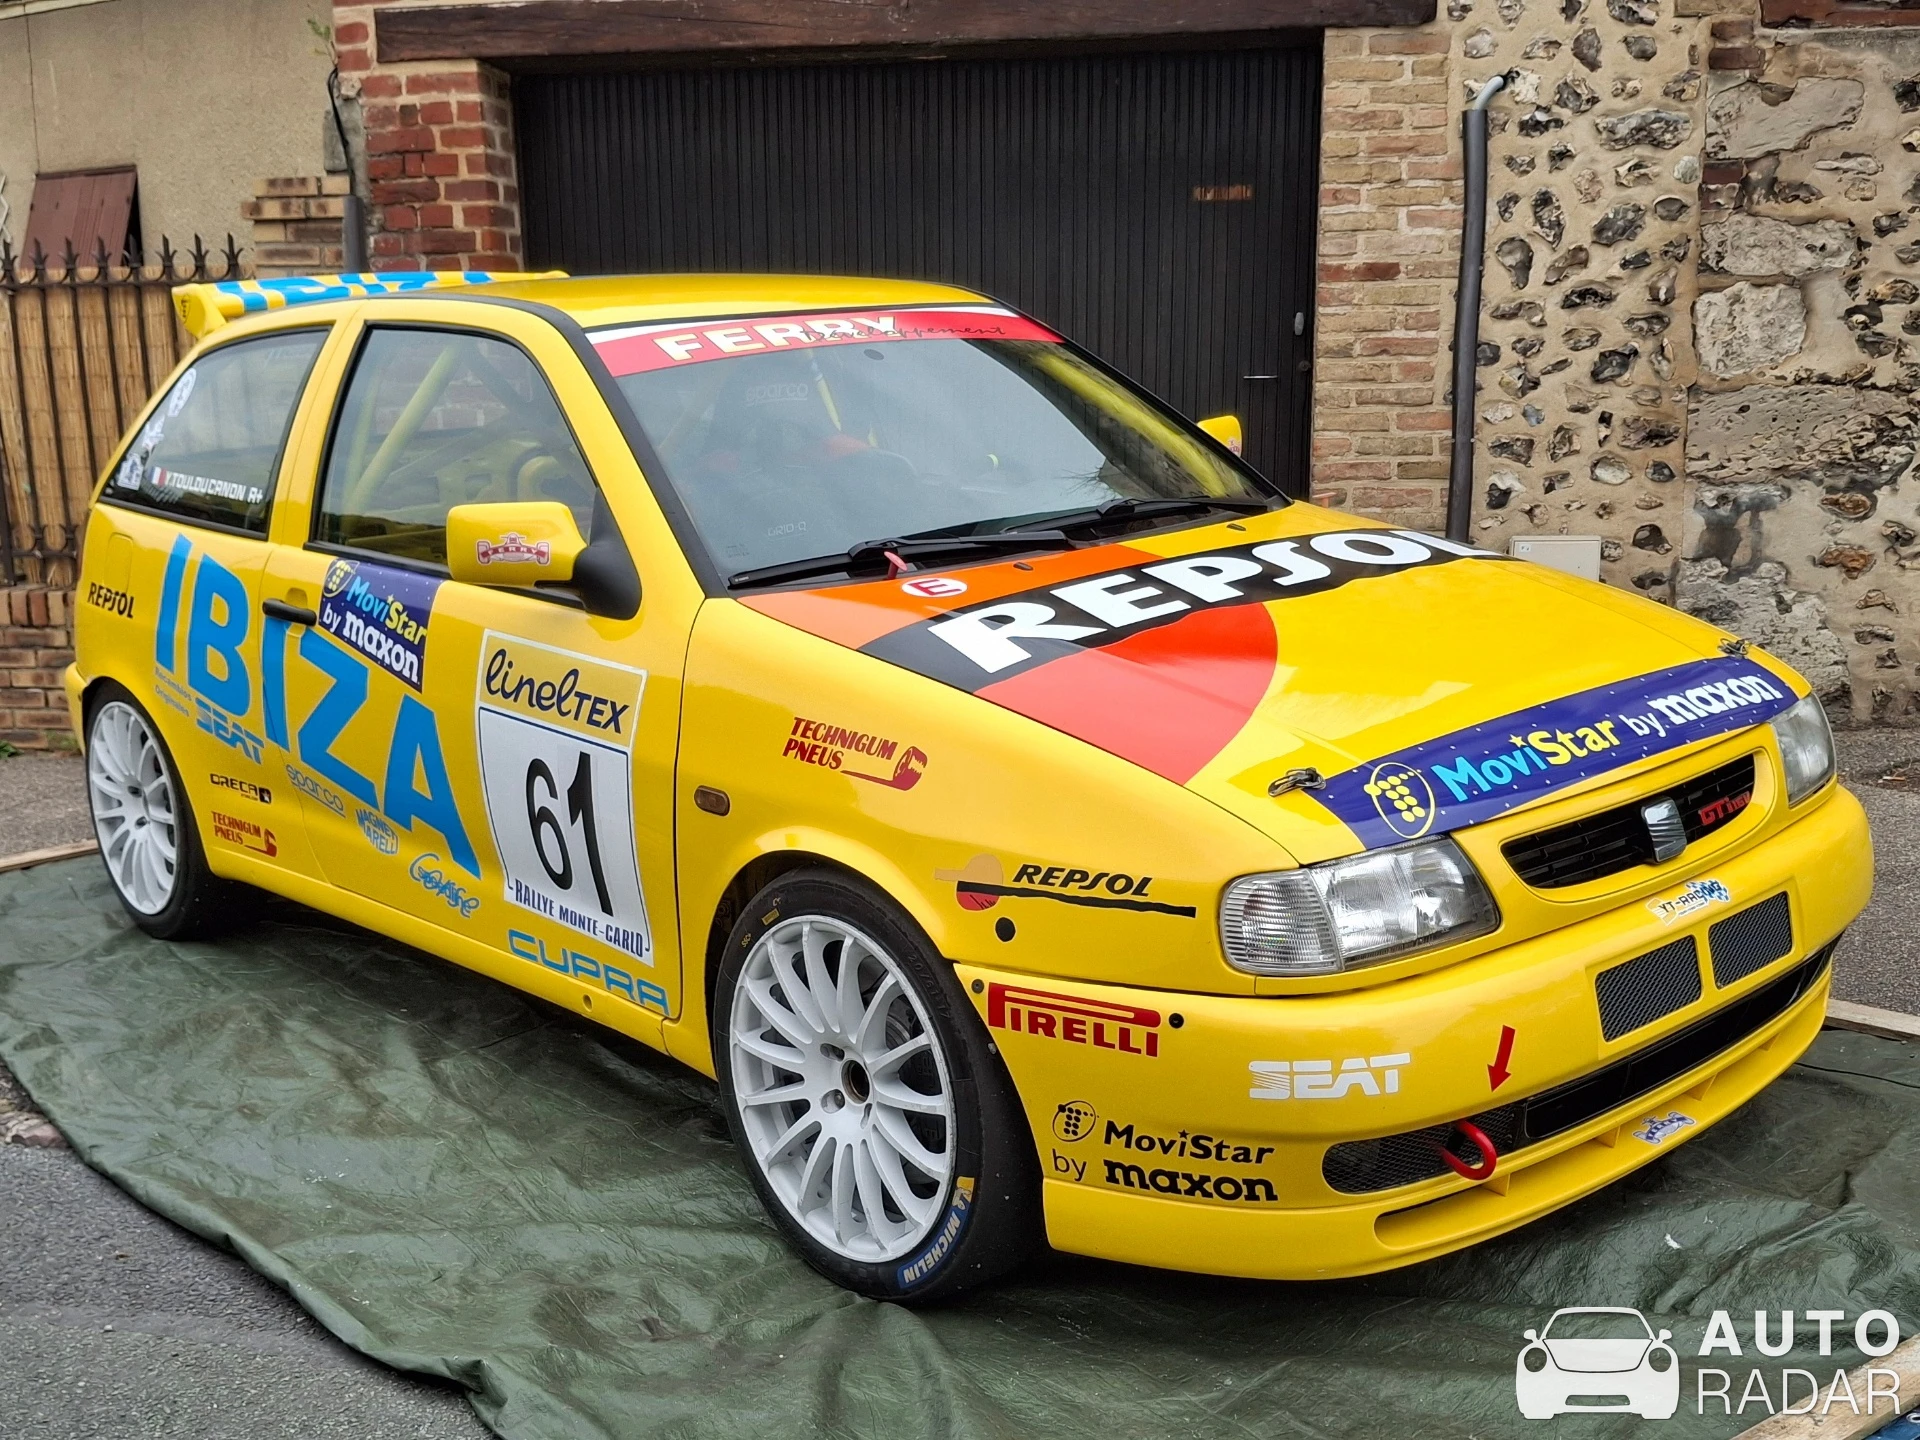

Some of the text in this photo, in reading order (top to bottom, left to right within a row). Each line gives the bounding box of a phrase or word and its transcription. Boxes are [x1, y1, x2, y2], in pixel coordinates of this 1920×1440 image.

[653, 315, 897, 361] FERRY
[87, 581, 135, 620] REPSOL
[346, 575, 428, 645] MoviStar
[927, 530, 1503, 674] REPSOL
[323, 602, 420, 684] by maxon
[154, 532, 482, 881] IBIZA
[195, 696, 265, 765] SEAT
[781, 737, 845, 771] PNEUS
[789, 716, 899, 761] TECHNIGUM
[1431, 674, 1784, 803] MoviStar by maxon
[285, 763, 345, 813] sparco
[211, 811, 262, 839] TECHNIGUM
[214, 825, 243, 846] PNEUS
[526, 750, 614, 917] 61
[1012, 863, 1152, 897] REPSOL
[515, 878, 645, 959] RALLYE MONTE-CARLO
[508, 928, 669, 1017] CUPRA
[987, 982, 1161, 1057] PIRELLI
[1248, 1053, 1411, 1099] SEAT
[1104, 1119, 1275, 1165] MoviStar
[1051, 1149, 1278, 1201] by maxon
[903, 1211, 961, 1284] MICHELIN
